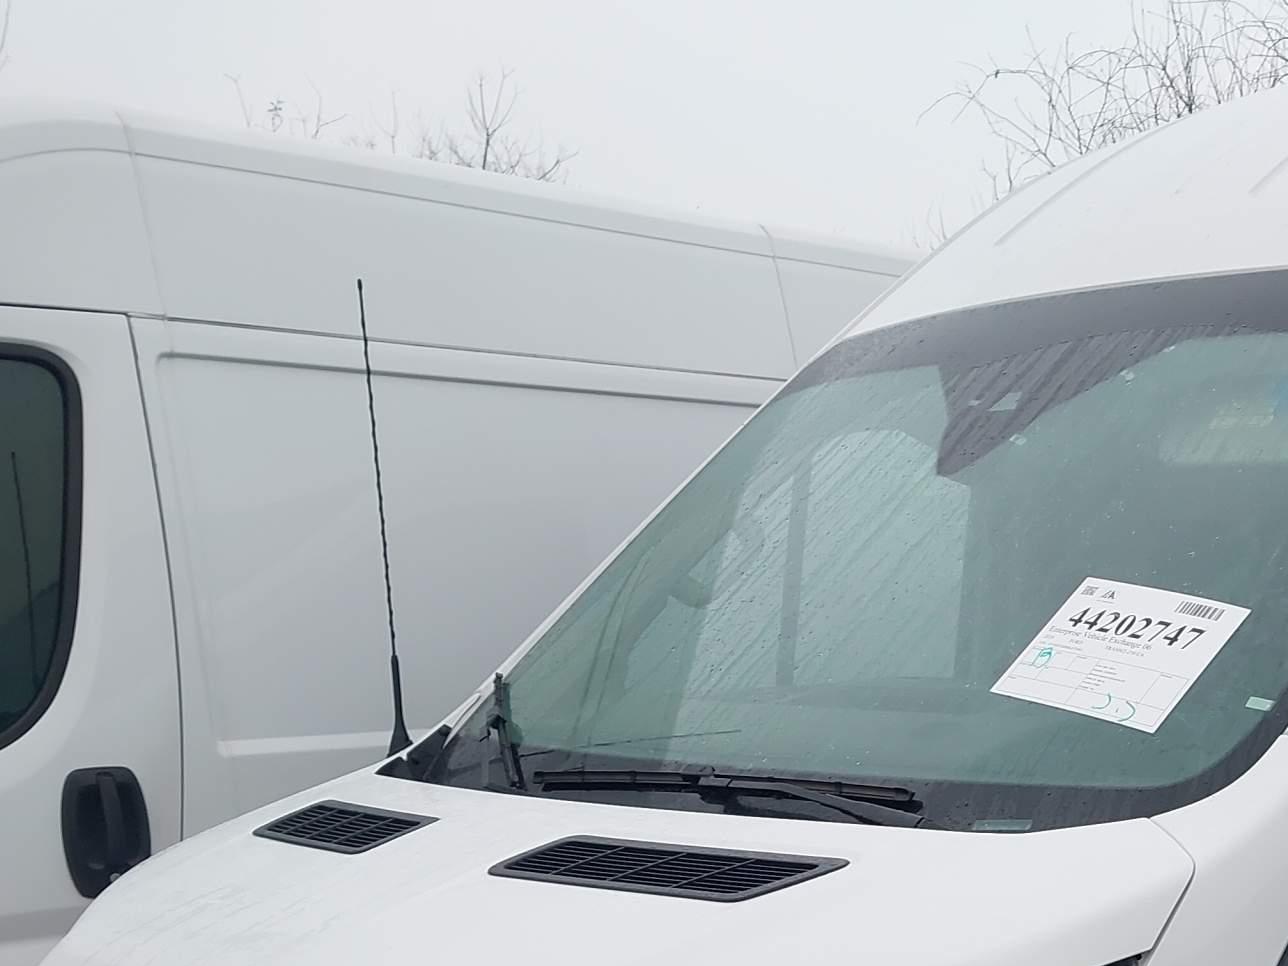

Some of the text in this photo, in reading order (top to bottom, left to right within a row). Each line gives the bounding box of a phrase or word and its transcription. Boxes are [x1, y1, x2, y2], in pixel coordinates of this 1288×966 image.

[1069, 607, 1206, 649] 44202747
[1083, 631, 1108, 641] Vehicle
[1108, 637, 1142, 649] Exchange
